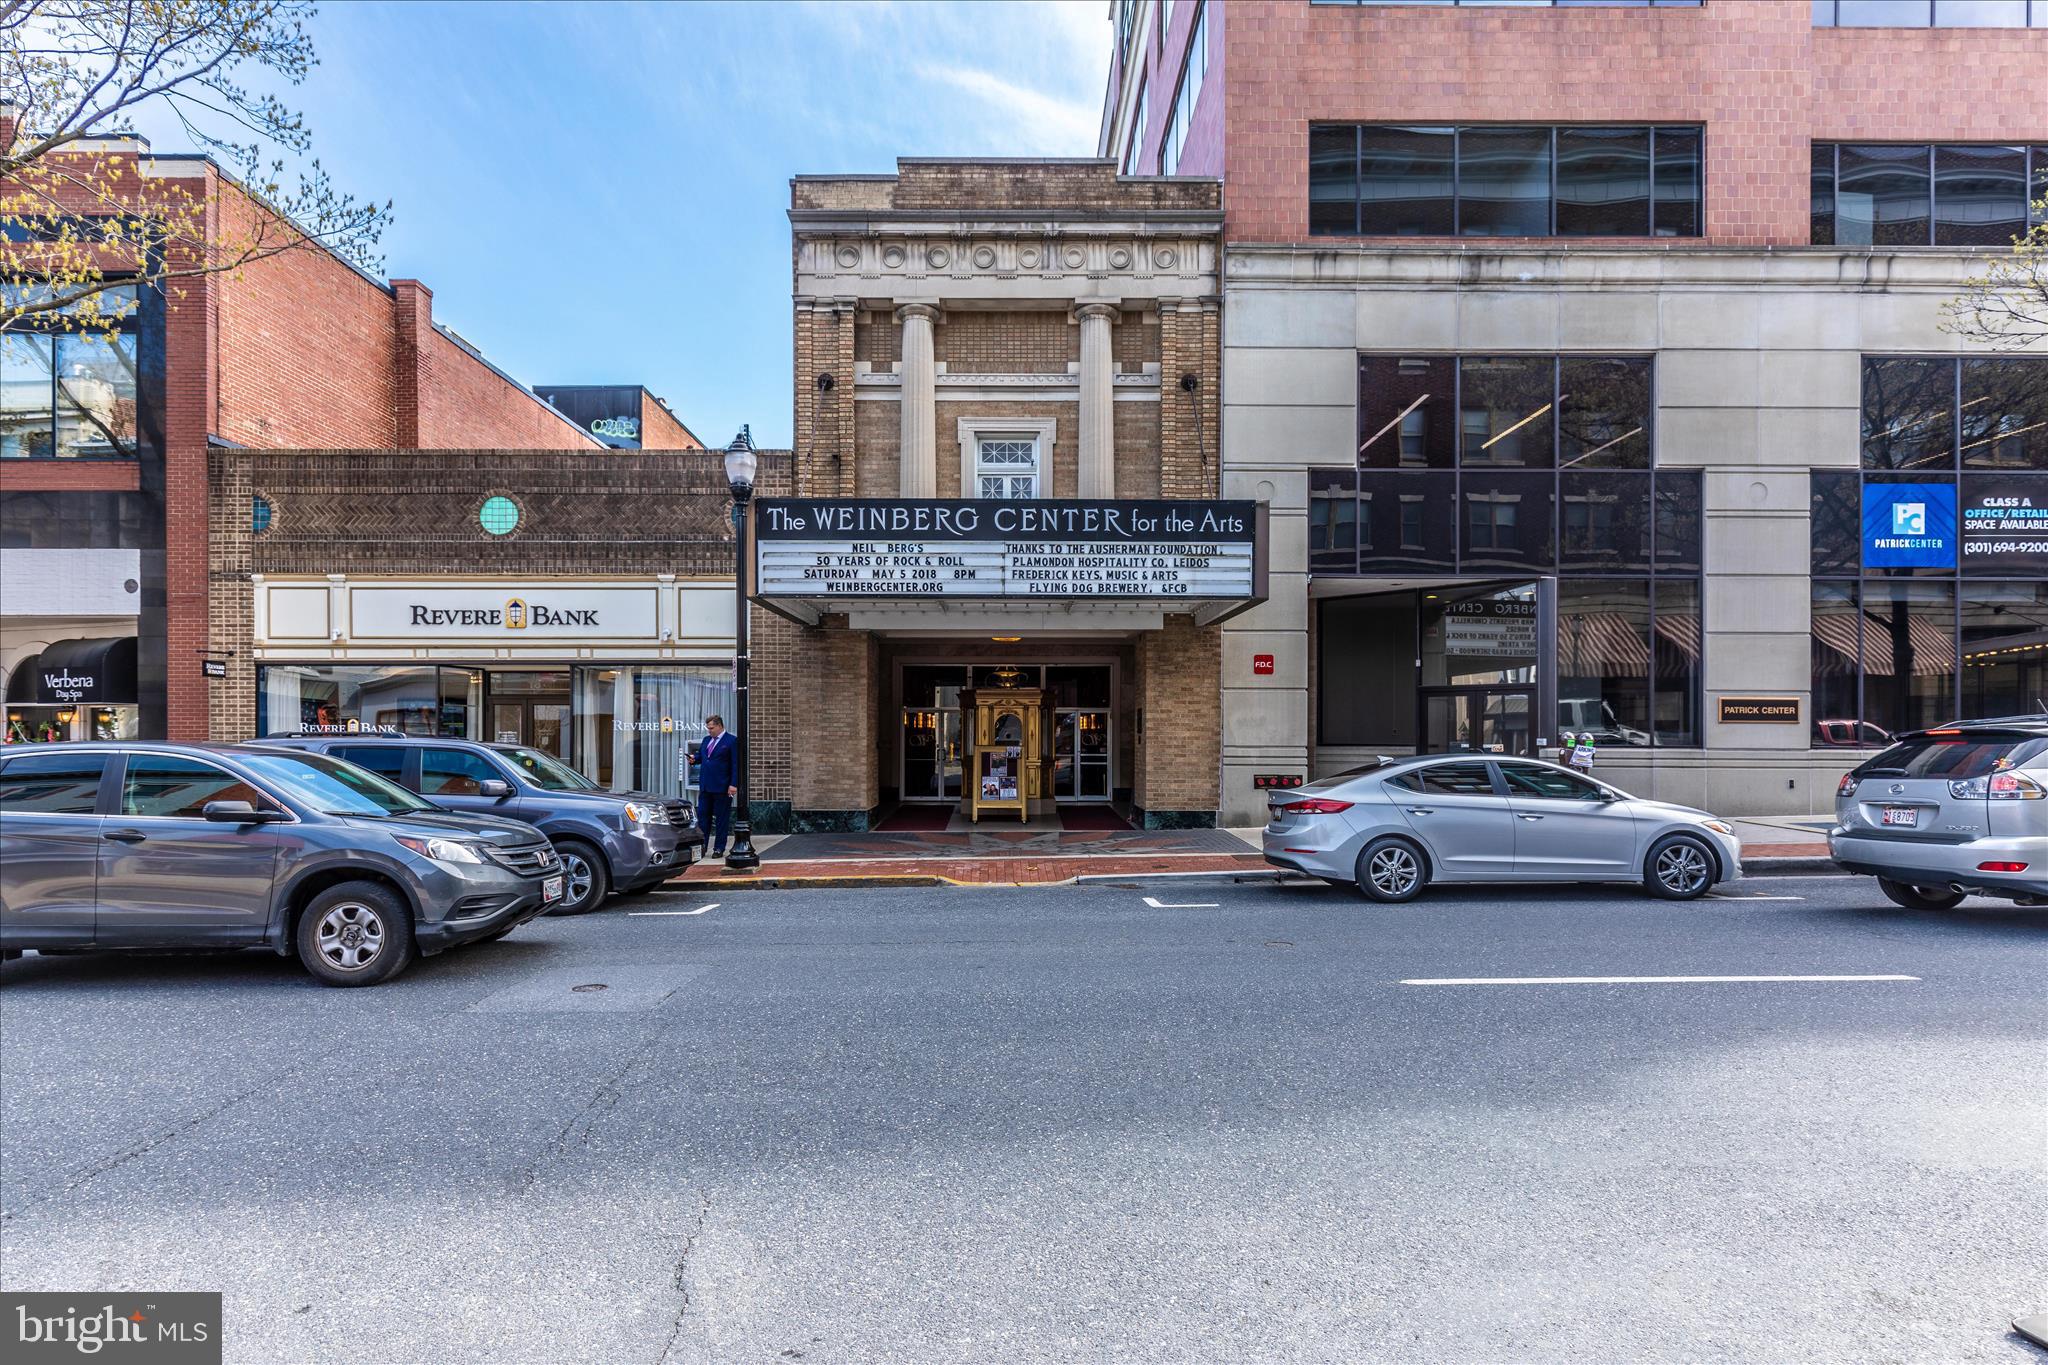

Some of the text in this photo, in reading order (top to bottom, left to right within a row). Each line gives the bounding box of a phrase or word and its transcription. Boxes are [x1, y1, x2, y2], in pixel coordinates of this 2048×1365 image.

[1982, 497, 2032, 507] CLASS A
[1964, 508, 2048, 519] OFFICE/RETAIL
[767, 506, 1243, 537] The WEINBERG CENTER for the Arts
[1964, 519, 2048, 530] SPACE AVAILABLE
[852, 543, 924, 553] NEIL BERG'S
[1006, 543, 1045, 554] THANKS
[1049, 544, 1063, 554] TO
[1066, 544, 1085, 554] THE
[1088, 544, 1150, 555] AUSHERMAN
[1874, 538, 1943, 549] PATRICKCENTER
[1964, 541, 2048, 555] (301) 694-9200
[816, 556, 965, 566] 50 YEARS OF ROCK & ROLL
[1012, 556, 1075, 567] PLAMONDON
[1078, 557, 1147, 567] HOSPITALITY
[1173, 558, 1210, 568] LEIDOS
[804, 568, 976, 579] SATURDAY MAY 5 2018 8PM
[1012, 569, 1068, 580] FREDERICK
[1106, 570, 1138, 580] MUSIC
[1141, 570, 1149, 580] &
[1151, 570, 1178, 580] ARTS
[826, 582, 944, 592] WEINBERGCENTER.ORG
[1029, 582, 1068, 593] FLYING
[1072, 583, 1093, 593] DOG
[1161, 583, 1188, 594] &FCB
[44, 668, 94, 688] Verbena
[69, 689, 83, 702] Spa
[1724, 706, 1796, 715] PATRICK CENTER
